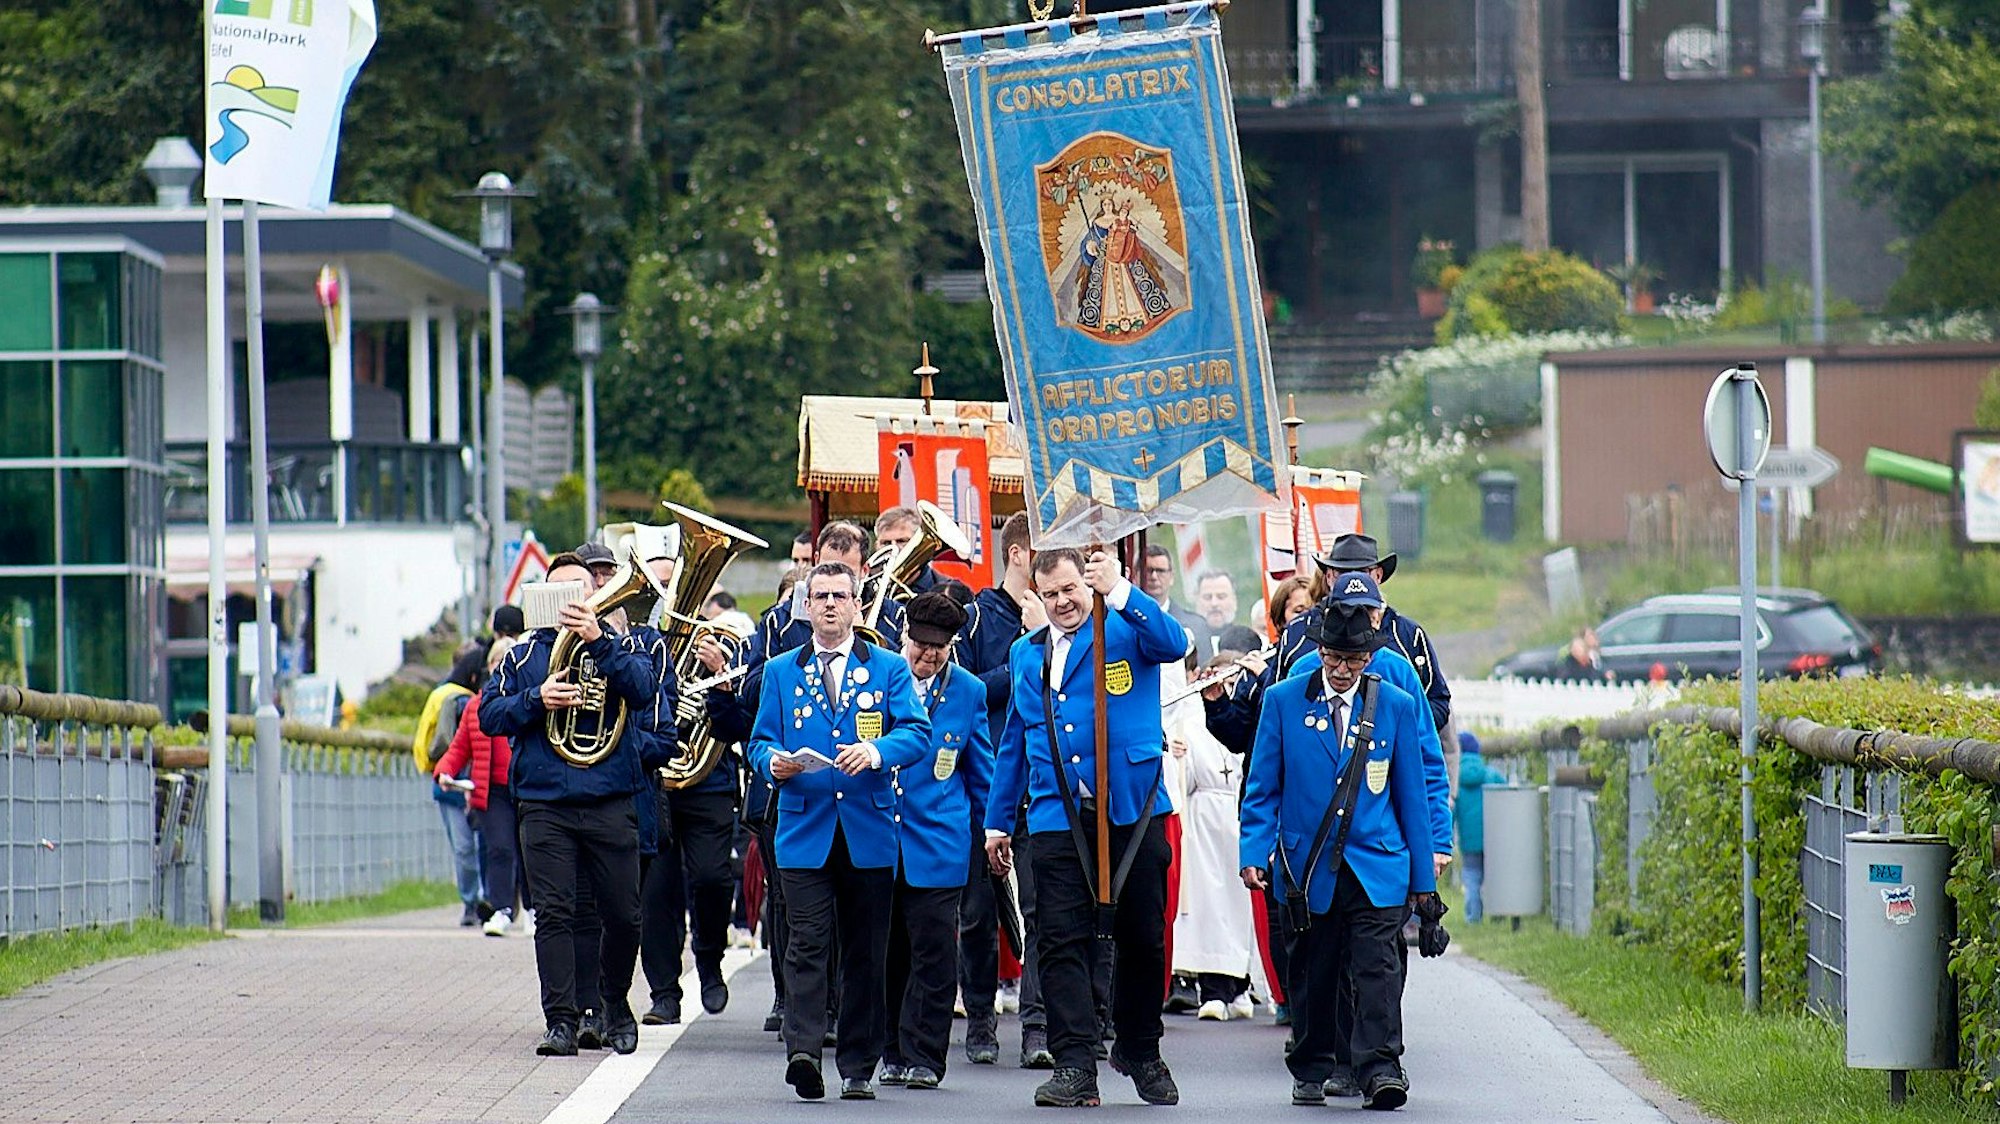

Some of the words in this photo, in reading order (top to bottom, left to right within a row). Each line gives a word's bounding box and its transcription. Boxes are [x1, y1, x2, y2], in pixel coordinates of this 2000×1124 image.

[996, 64, 1190, 113] CONSOLATRIX
[1042, 359, 1233, 409] AFFLICTORUM
[1049, 414, 1098, 443] ORA
[1156, 394, 1237, 430] NOBIS
